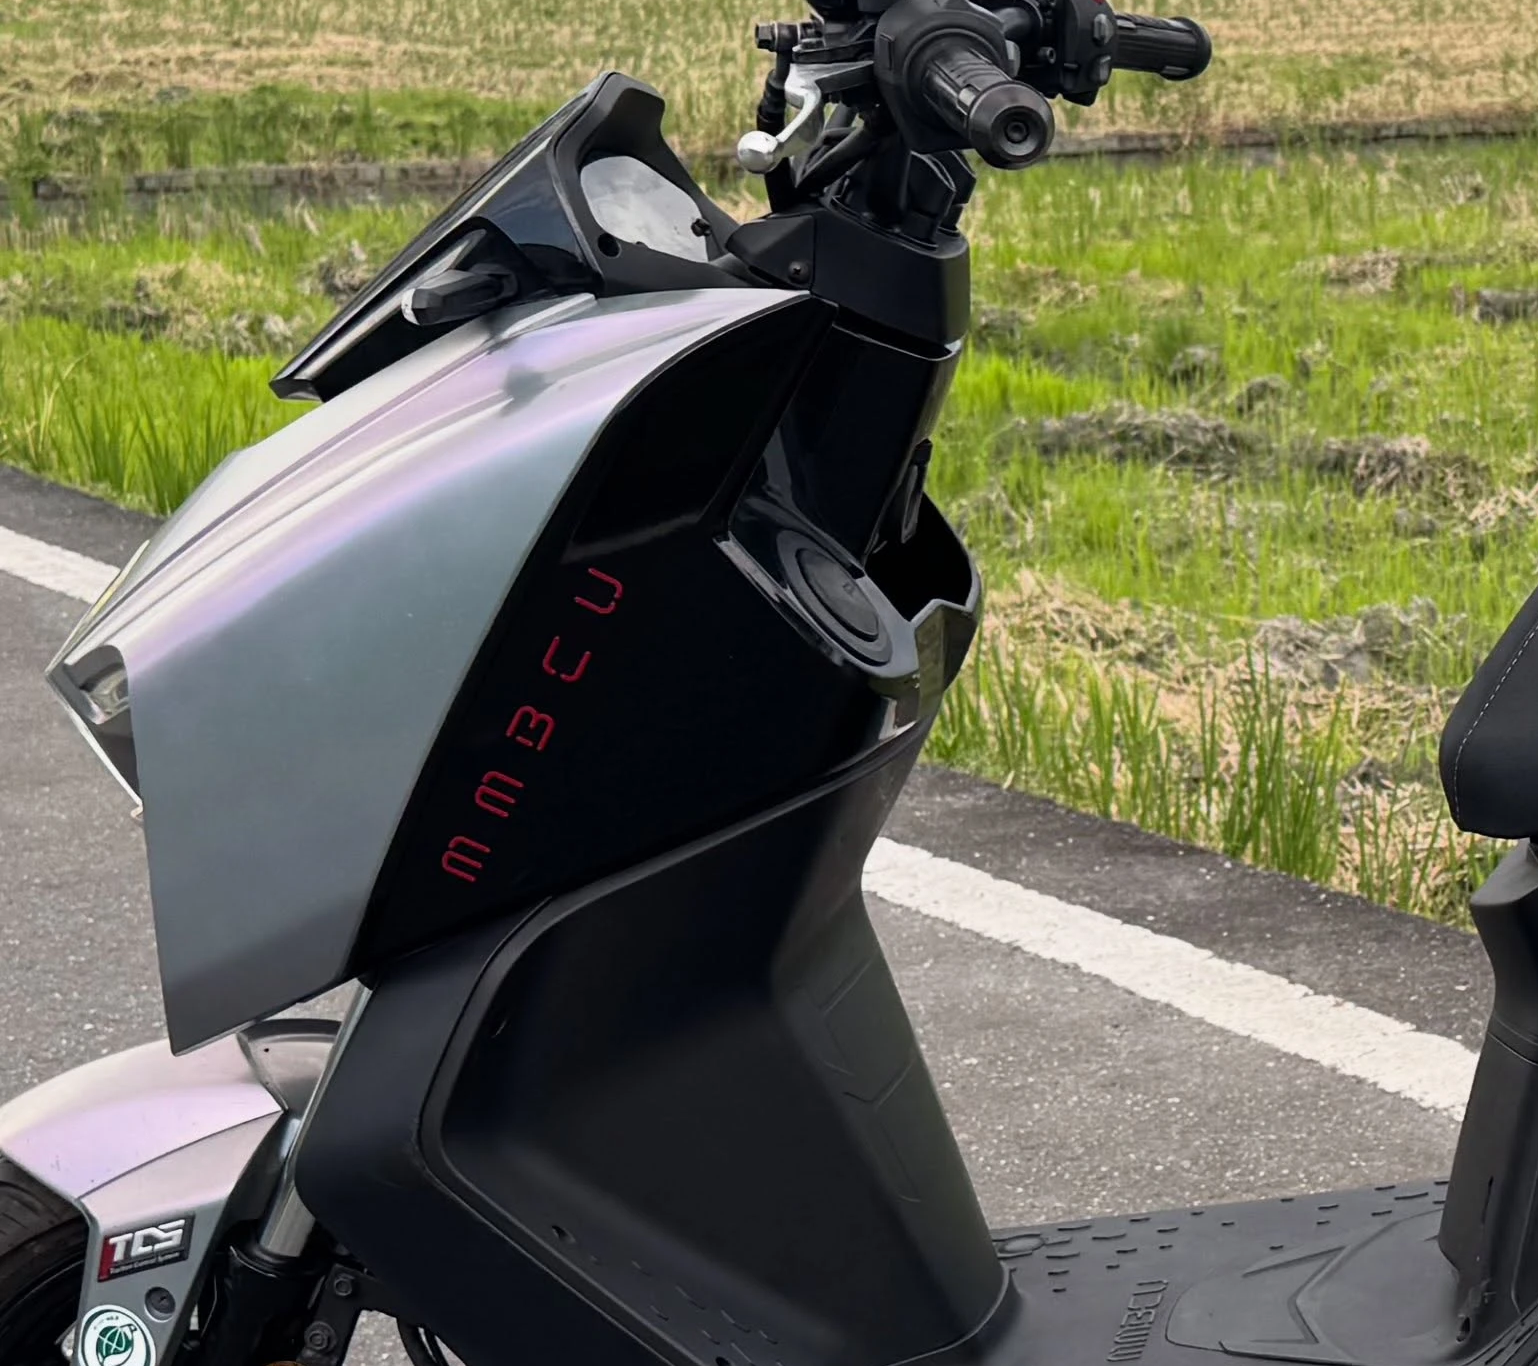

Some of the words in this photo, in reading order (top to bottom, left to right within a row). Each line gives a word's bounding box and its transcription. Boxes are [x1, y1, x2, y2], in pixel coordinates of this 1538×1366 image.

[442, 568, 624, 882] MMBCU
[109, 1219, 185, 1262] TCS
[1106, 1280, 1168, 1362] MMBCU
